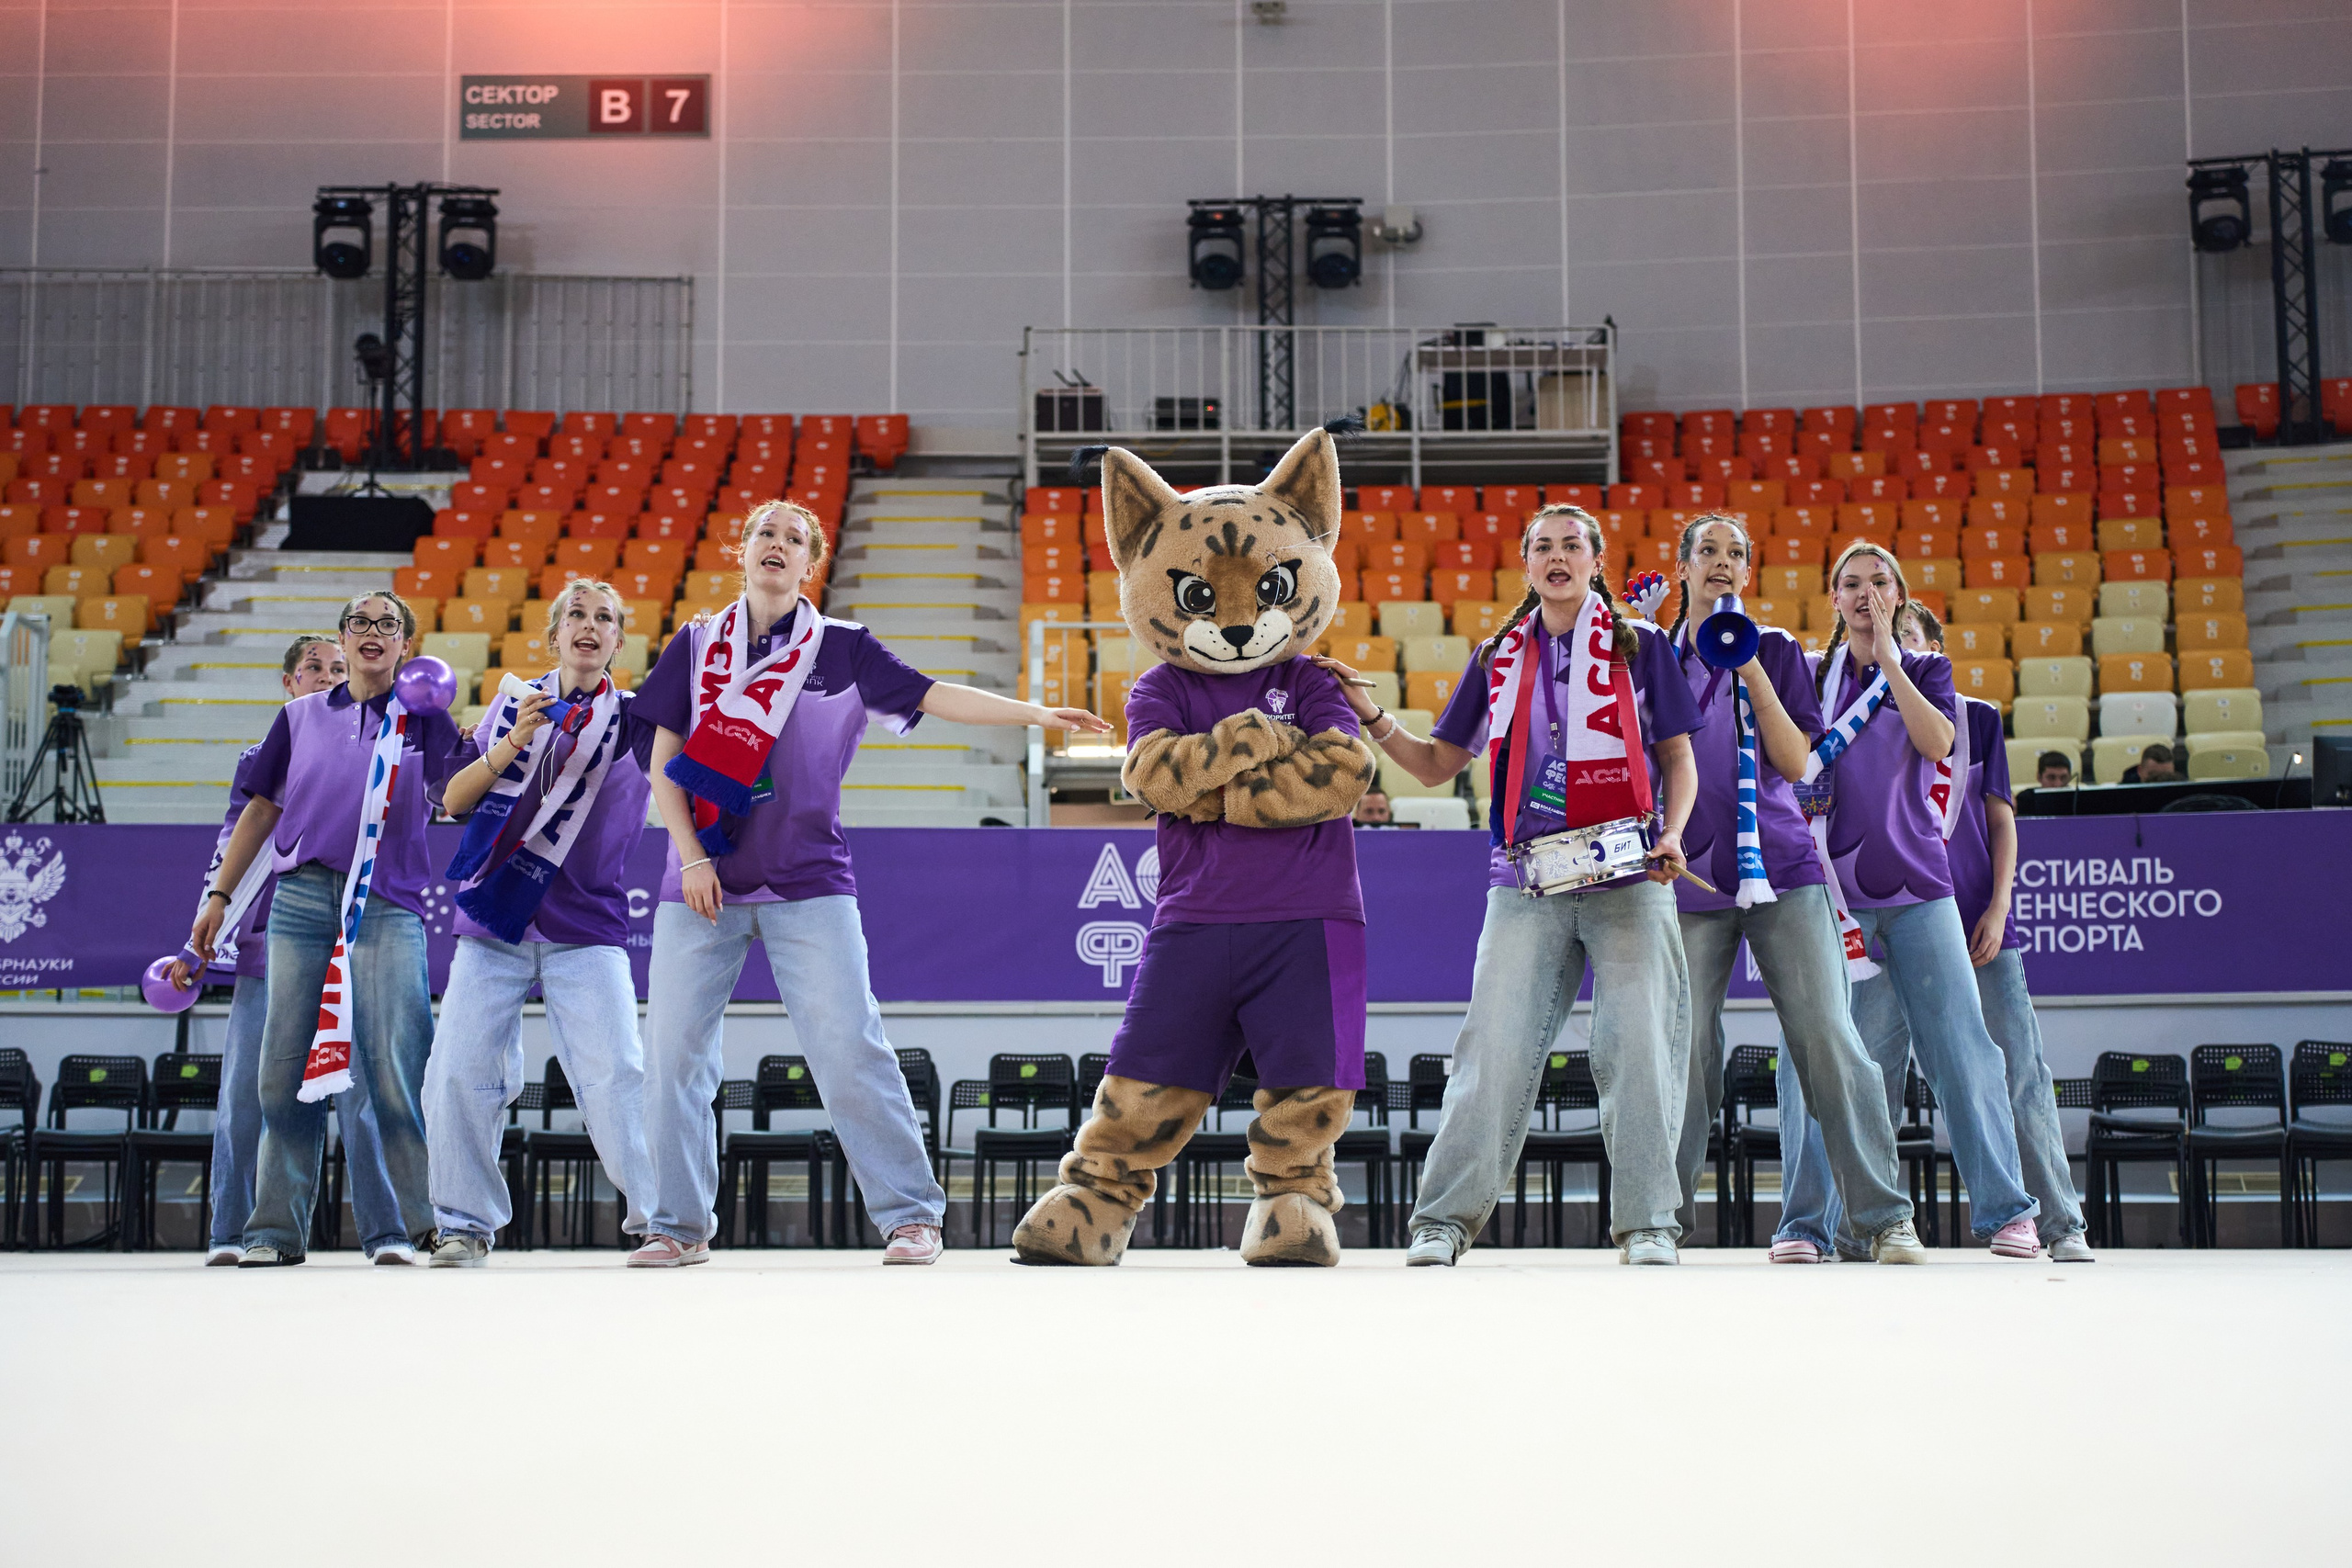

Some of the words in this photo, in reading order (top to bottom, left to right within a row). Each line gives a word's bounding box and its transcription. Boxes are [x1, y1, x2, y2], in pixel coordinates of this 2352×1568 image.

[465, 85, 559, 105] СЕКТОР
[600, 89, 632, 123] B
[664, 89, 690, 123] 7
[465, 113, 541, 130] SECTOR
[1263, 713, 1295, 721] РИОРИТЕТ
[1614, 840, 1632, 853] БИТ
[2015, 888, 2222, 920] ЕНЧЕСКОГО
[0, 958, 74, 972] РНАУКИ
